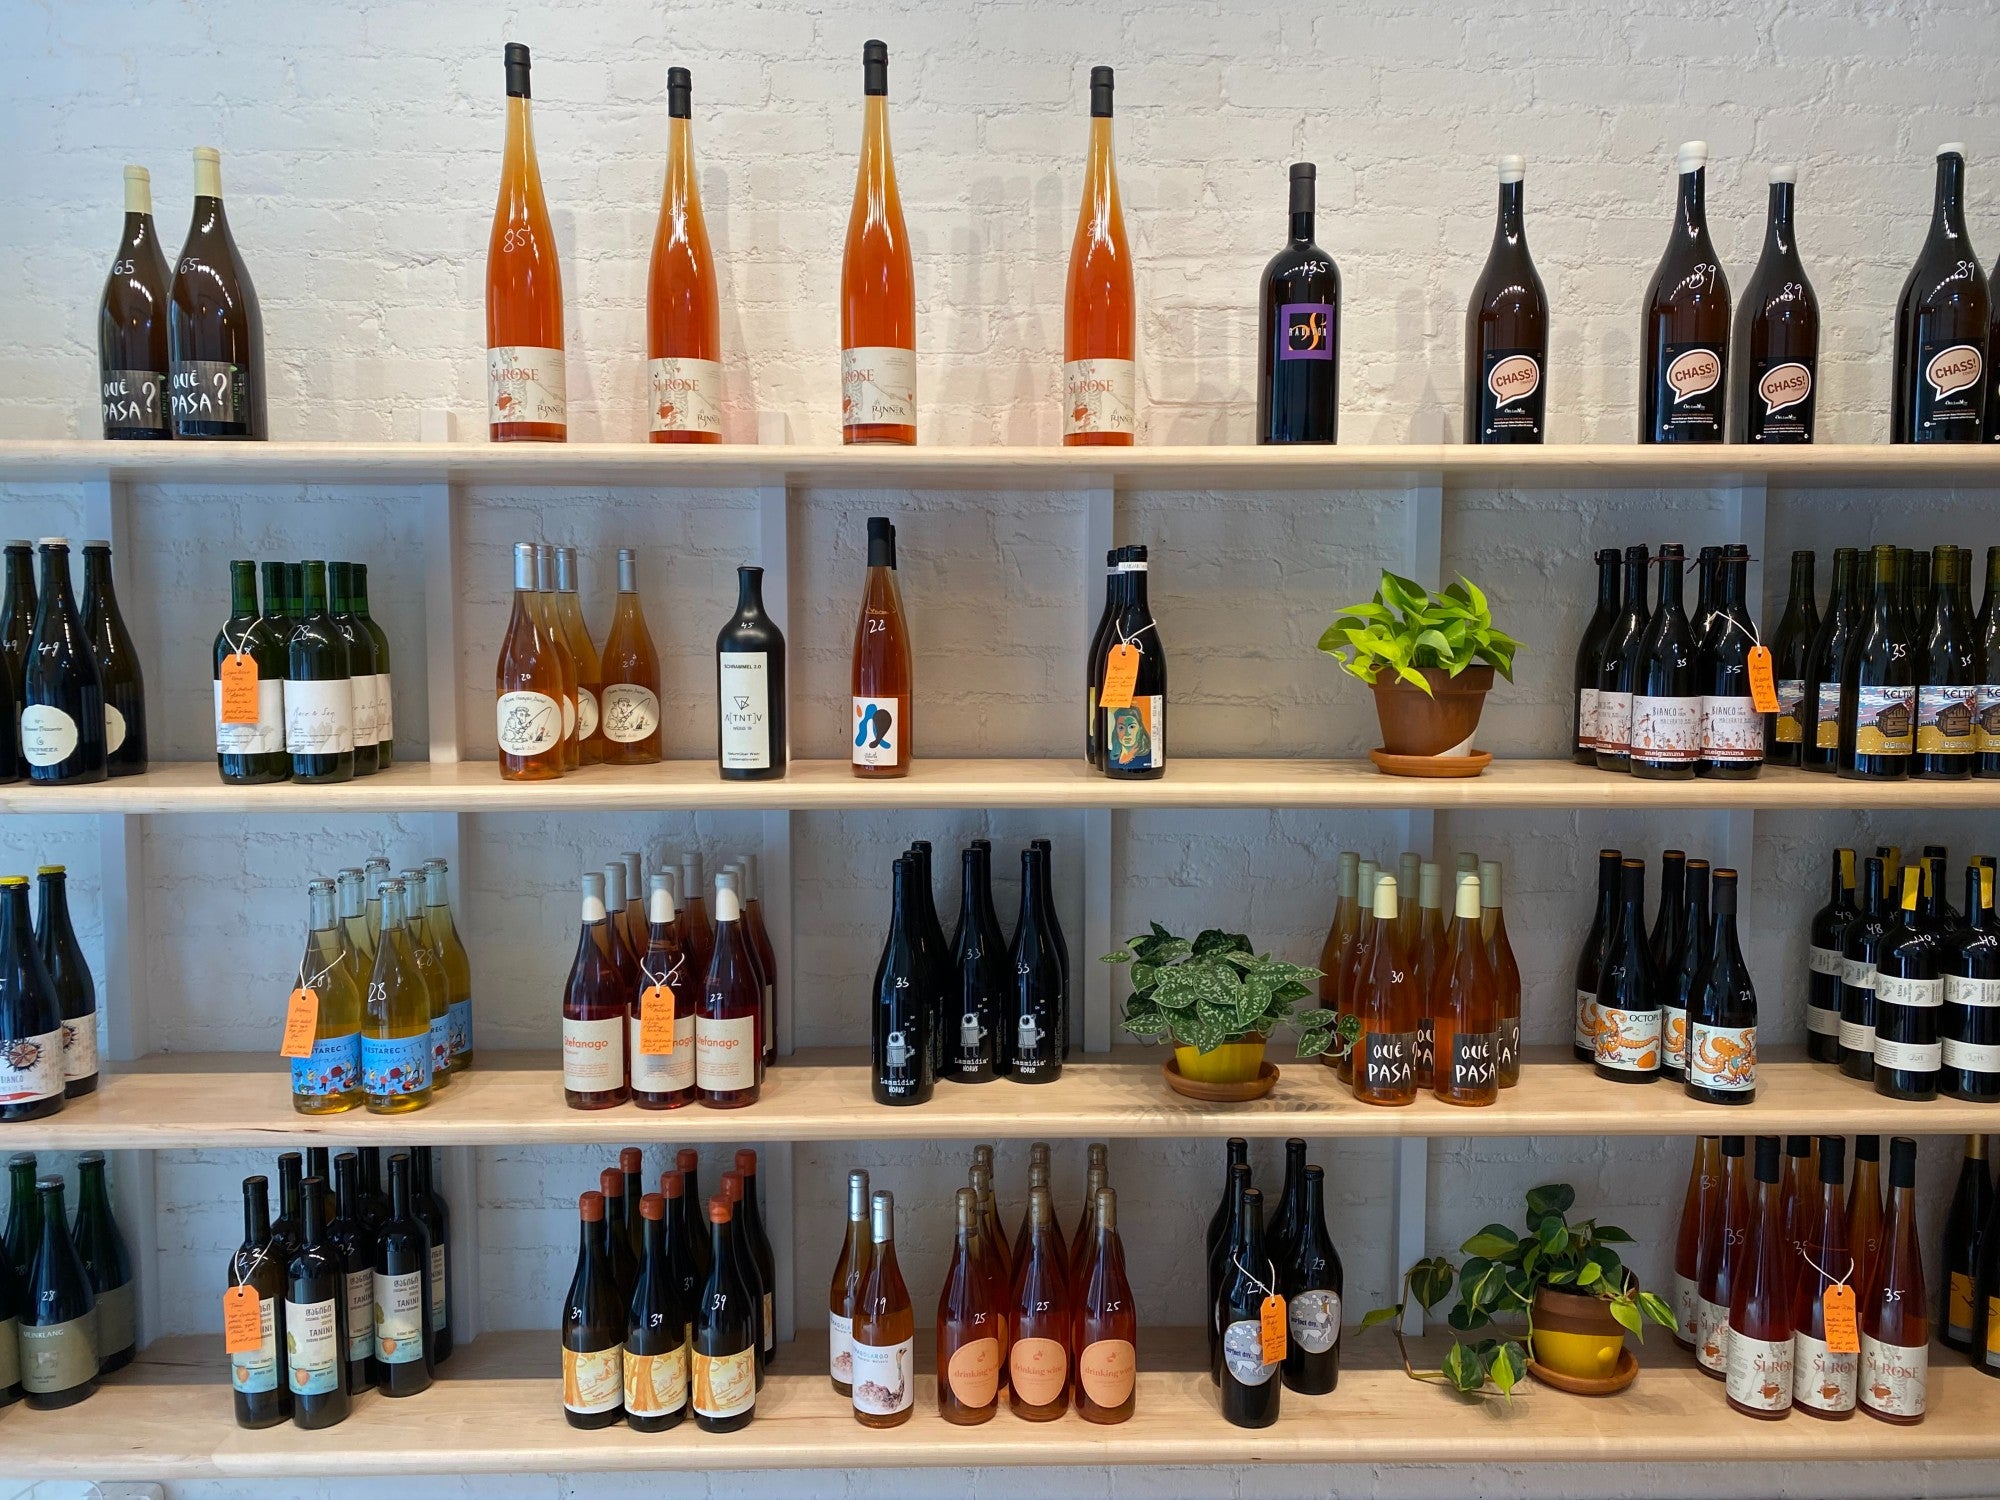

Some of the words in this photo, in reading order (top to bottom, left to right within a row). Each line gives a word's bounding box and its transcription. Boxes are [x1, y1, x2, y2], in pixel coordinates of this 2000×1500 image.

[504, 225, 531, 253] 85
[113, 259, 135, 275] 65
[179, 257, 200, 275] 65
[1689, 263, 1717, 294] 89
[1783, 283, 1803, 302] 89
[501, 368, 539, 381] ROSE
[1675, 363, 1715, 382] CHASS!
[1935, 358, 1977, 380] CHASS!
[664, 379, 699, 391] ROSE
[1079, 379, 1114, 392] ROSE
[1496, 368, 1534, 387] CHASS!
[1767, 375, 1806, 395] CHASS!
[103, 401, 142, 423] PASA
[171, 392, 212, 416] PASA
[291, 624, 311, 643] 28
[868, 619, 886, 633] 22
[38, 641, 59, 657] 49
[1892, 643, 1907, 661] 35
[1605, 660, 1617, 672] 35
[1677, 658, 1687, 668] 35
[1726, 665, 1743, 674] 35
[521, 673, 531, 682] 20
[1652, 706, 1677, 716] BIANCO
[1711, 706, 1736, 716] BIANCO
[1866, 923, 1883, 934] 48
[1978, 935, 1998, 947] 48
[1391, 970, 1404, 983] 30
[368, 982, 387, 1002] 28
[710, 993, 723, 1002] 22
[1373, 1042, 1403, 1059] QUÉ
[1461, 1042, 1490, 1059] QUÉ
[1368, 1062, 1411, 1084] PASA
[1455, 1062, 1496, 1084] PASA
[1725, 1228, 1744, 1245] 35
[42, 1290, 56, 1301] 28
[397, 1297, 419, 1308] TANINI
[711, 1293, 727, 1311] 39
[1884, 1288, 1906, 1302] 35
[873, 1297, 887, 1315] 19
[1036, 1301, 1050, 1311] 25
[1106, 1301, 1121, 1312] 25
[974, 1312, 987, 1324] 25
[309, 1325, 333, 1337] TANINI
[1084, 1366, 1119, 1378] drinking
[1882, 1362, 1918, 1379] ROSE
